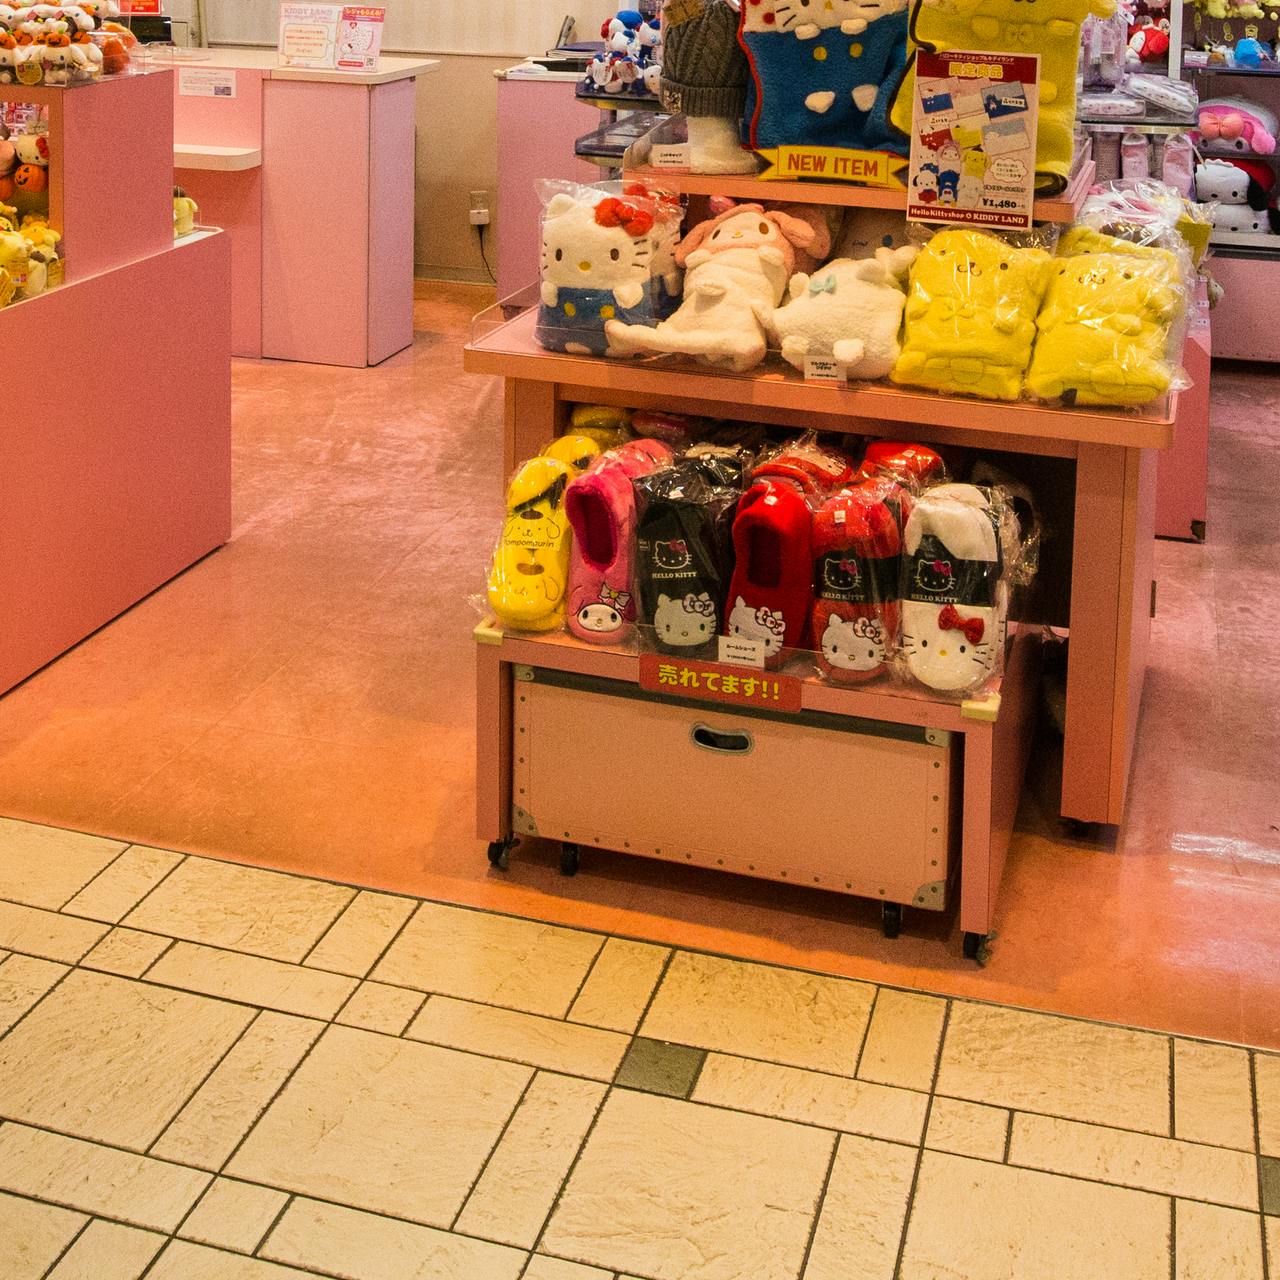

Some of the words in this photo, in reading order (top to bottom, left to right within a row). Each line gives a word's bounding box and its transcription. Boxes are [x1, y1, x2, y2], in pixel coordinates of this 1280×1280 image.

[949, 62, 1003, 78] 限定商品
[787, 153, 827, 173] NEW
[833, 156, 878, 177] ITEM
[983, 198, 1017, 209] ¥1,480
[973, 213, 1000, 221] KIDDY
[1001, 216, 1025, 224] LAND
[842, 593, 865, 601] KITTY
[658, 664, 780, 701] 売れてます!!
